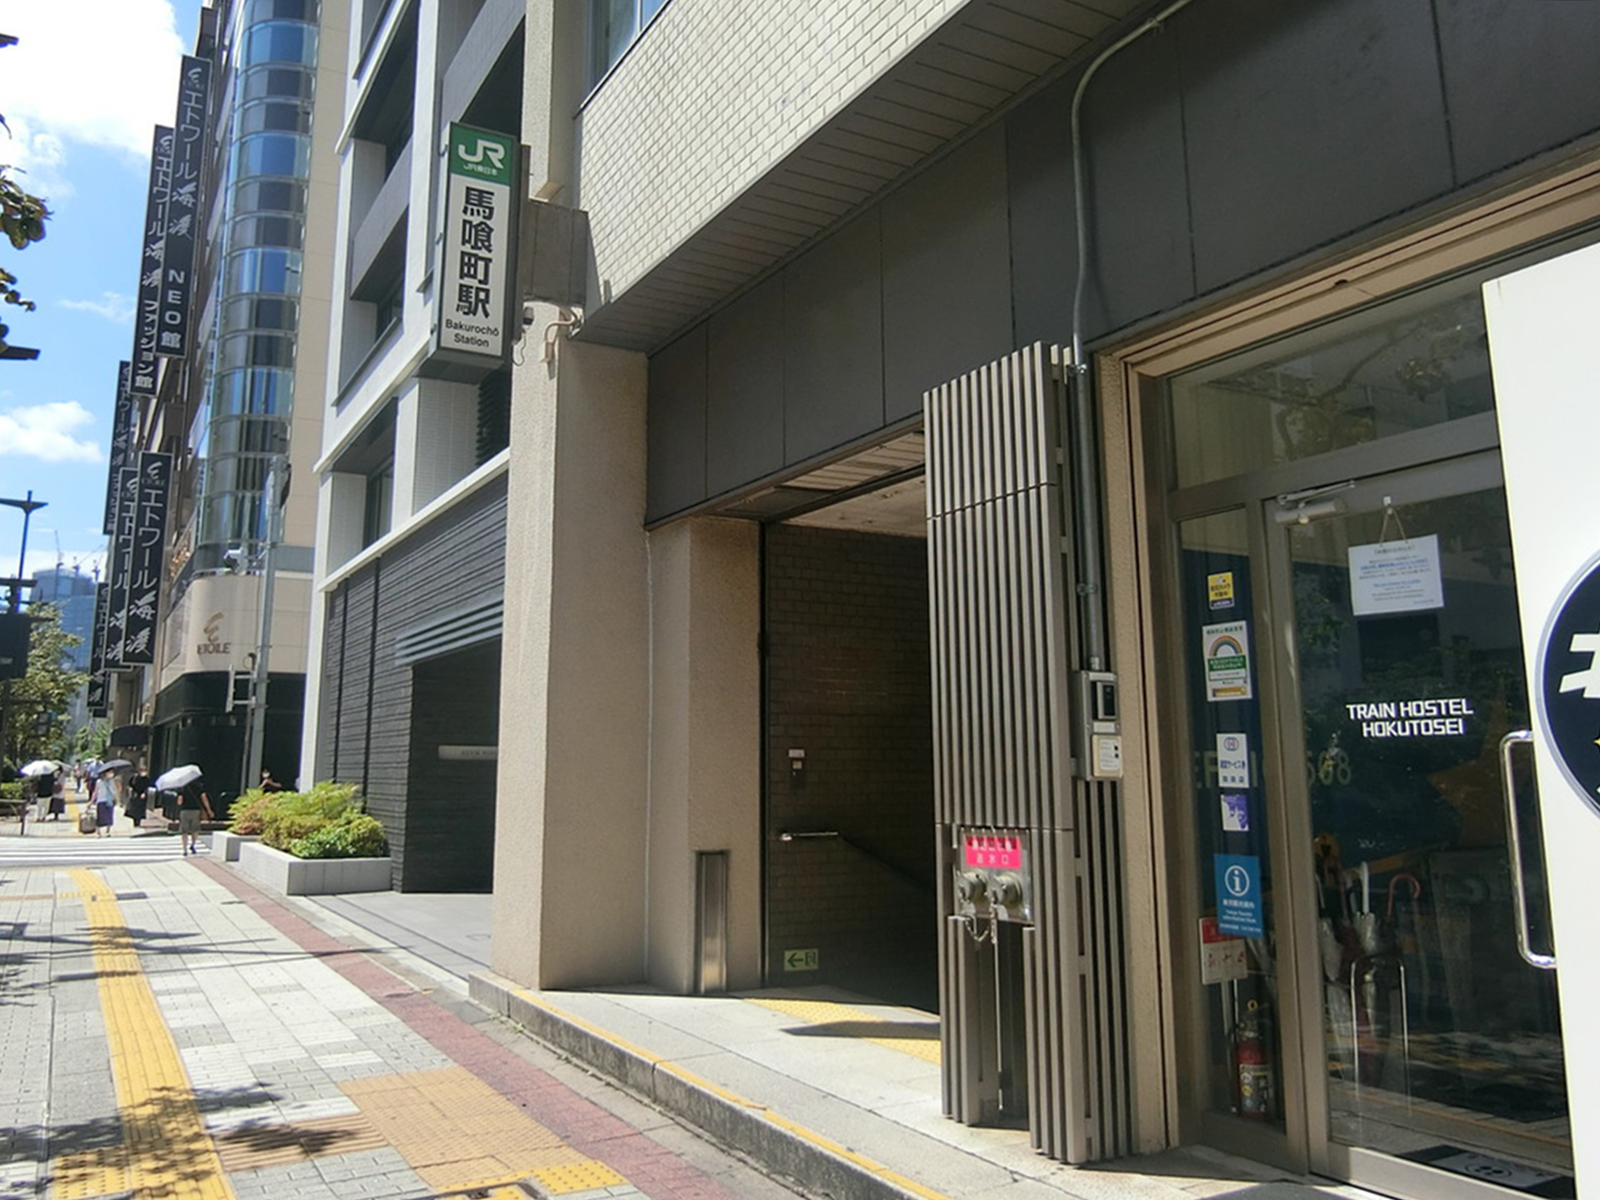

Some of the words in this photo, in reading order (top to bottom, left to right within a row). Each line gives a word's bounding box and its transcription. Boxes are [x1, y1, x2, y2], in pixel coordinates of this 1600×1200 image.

[458, 139, 505, 169] JR
[456, 186, 495, 318] 馬喰町駅
[454, 332, 490, 348] Station
[1346, 702, 1397, 720] TRAIN
[1400, 698, 1473, 717] HOSTEL
[1362, 718, 1464, 738] HOKUTOSEI
